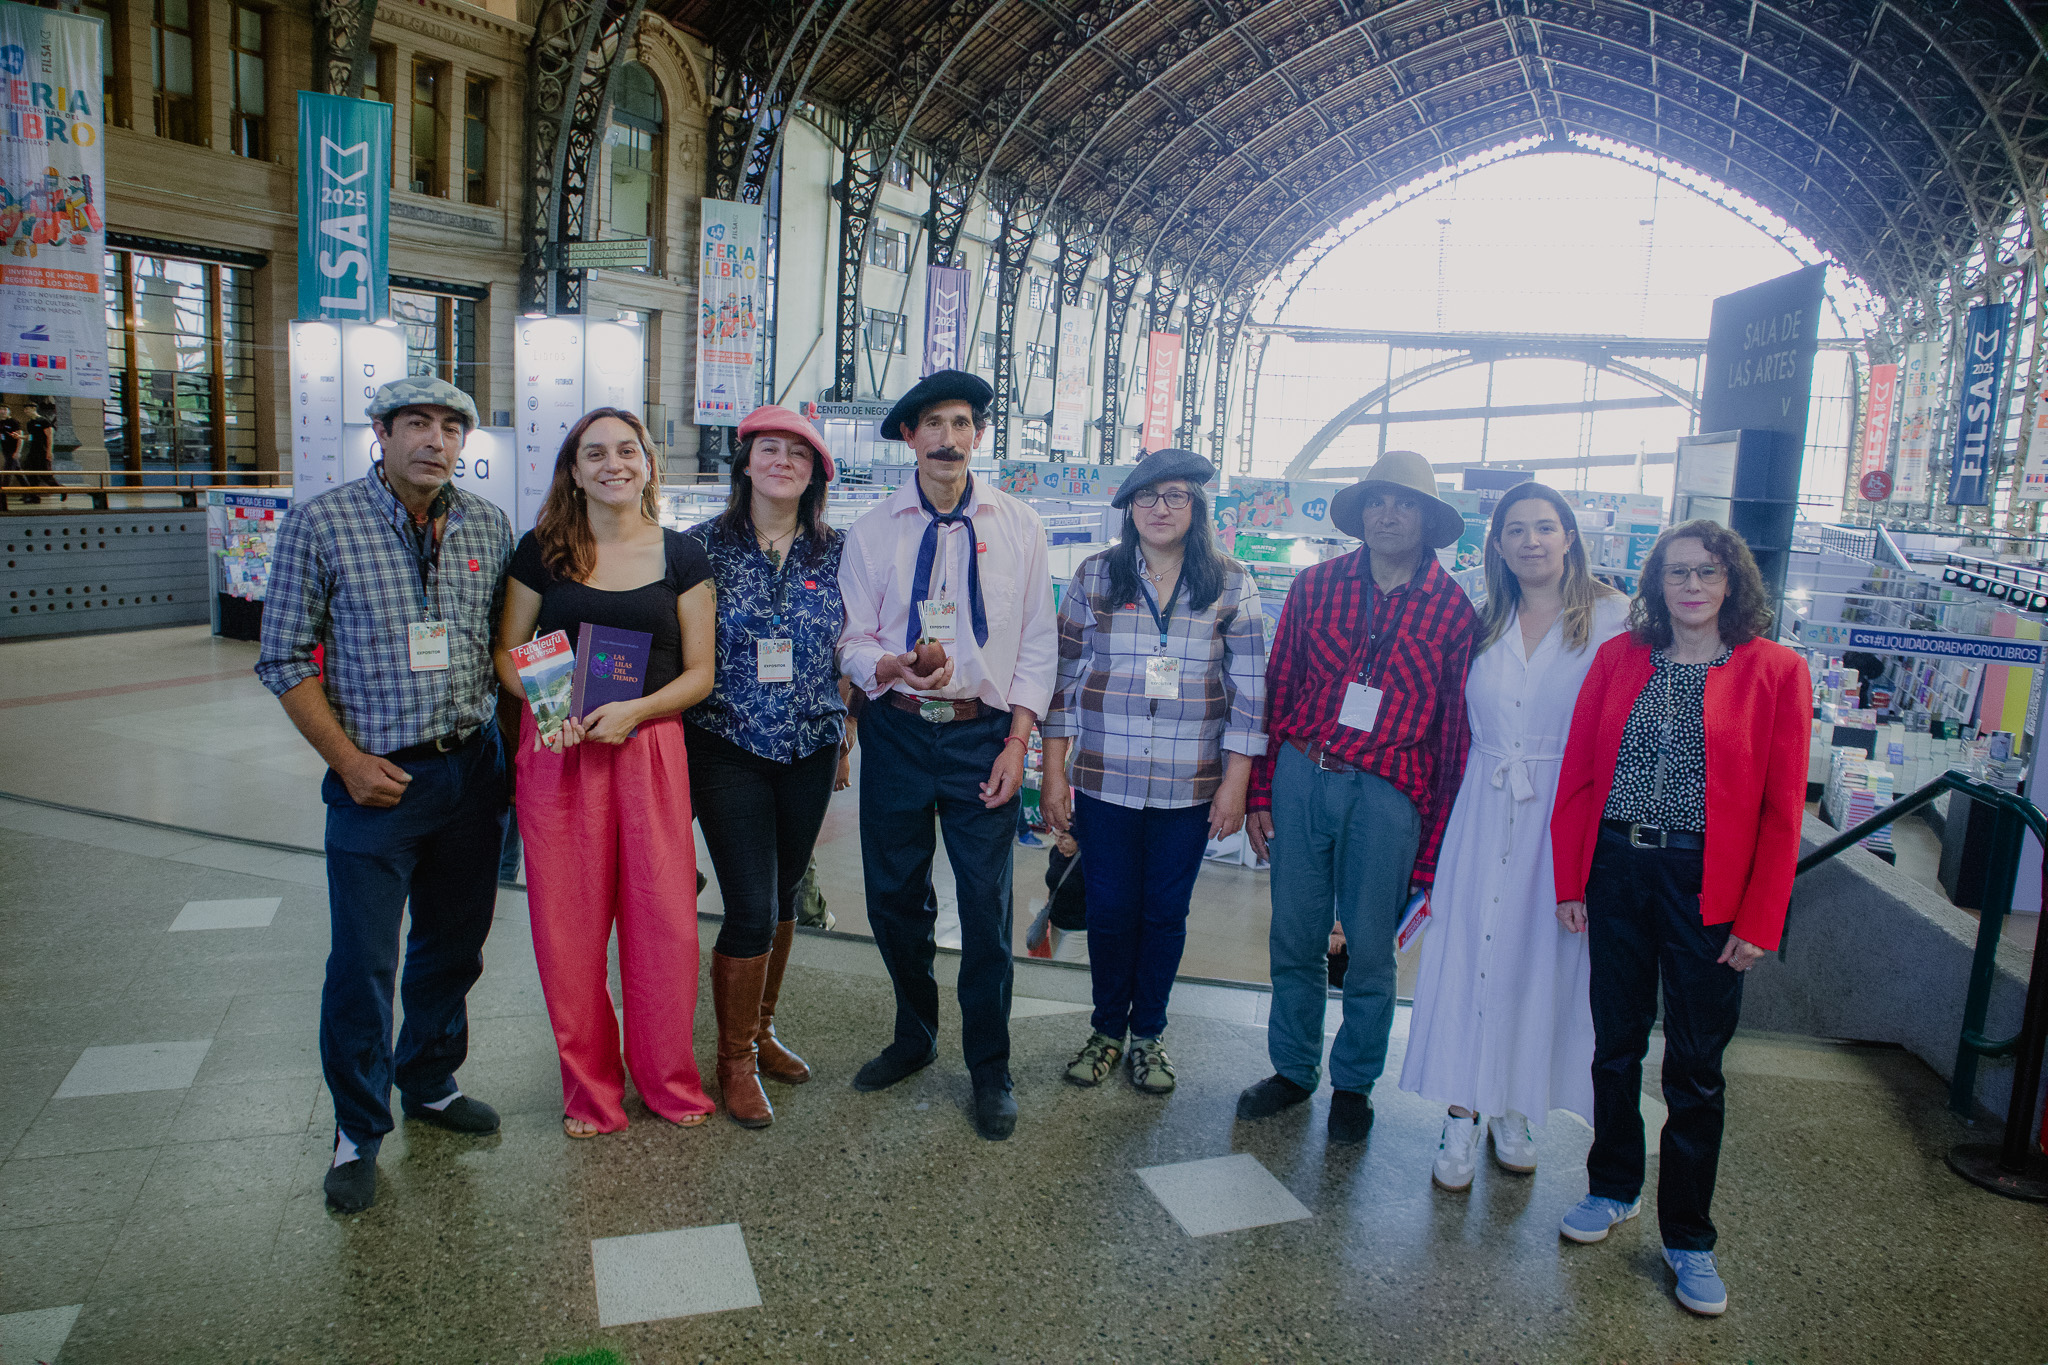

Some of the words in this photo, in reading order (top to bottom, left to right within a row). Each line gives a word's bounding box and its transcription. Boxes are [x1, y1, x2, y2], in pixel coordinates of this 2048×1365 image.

[41, 43, 52, 73] FILSA
[0, 111, 96, 147] IBRO
[321, 187, 367, 207] 2025
[705, 241, 755, 262] FERIA
[320, 213, 368, 320] LSA
[705, 260, 756, 280] LIBRO
[8, 268, 43, 277] INVITADA
[45, 271, 56, 279] DE
[57, 273, 85, 282] HONOR
[35, 278, 45, 286] DE
[47, 279, 63, 288] LOS
[64, 281, 89, 290] LAGOS
[16, 297, 43, 305] CENTRO
[935, 316, 957, 328] 2025
[1744, 316, 1777, 351] SALA
[1781, 309, 1803, 342] DE
[1062, 332, 1088, 346] FERA
[1728, 359, 1752, 389] LAS
[1754, 349, 1797, 385] ARTES
[1972, 362, 1995, 375] 2025
[816, 405, 850, 415] CENTRO
[852, 406, 863, 415] DE
[1149, 378, 1170, 438] FILSA
[1960, 376, 1994, 477] FILSA
[1046, 476, 1058, 485] 44
[1063, 467, 1100, 480] FERIA
[1062, 481, 1100, 495] LIBRO
[236, 496, 253, 506] HORA
[254, 497, 263, 506] DE
[1599, 494, 1627, 505] FERA
[1307, 502, 1325, 517] 44
[518, 634, 562, 657] Futaleufú
[527, 654, 535, 662] en
[614, 661, 632, 669] LILAS
[614, 667, 627, 675] DEL
[612, 674, 638, 683] TIEMPO
